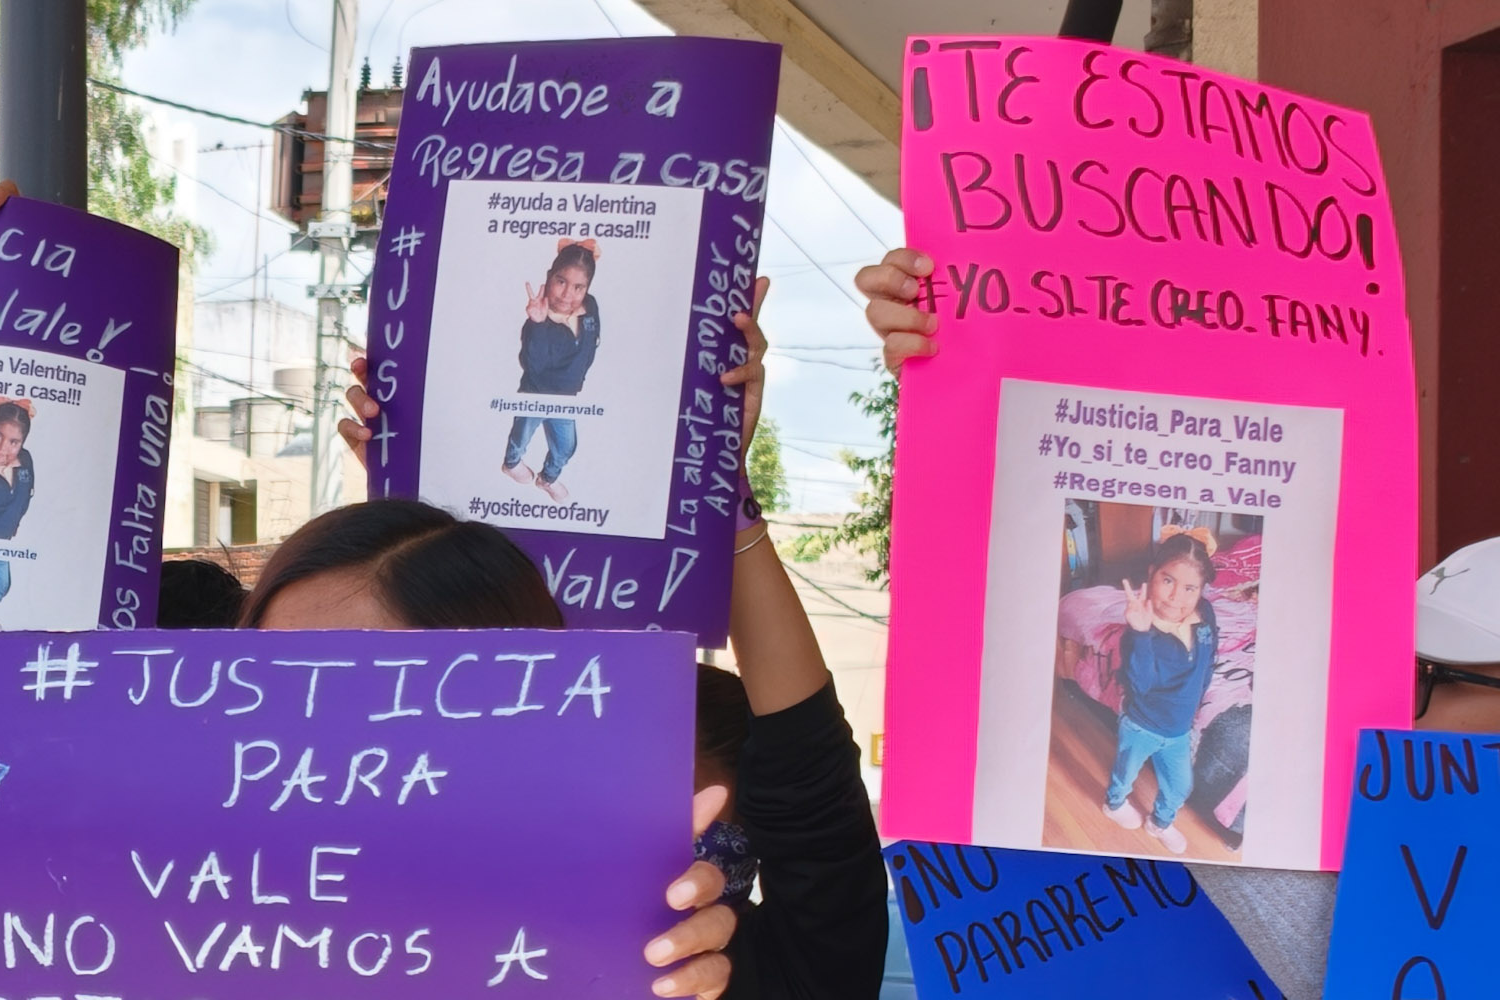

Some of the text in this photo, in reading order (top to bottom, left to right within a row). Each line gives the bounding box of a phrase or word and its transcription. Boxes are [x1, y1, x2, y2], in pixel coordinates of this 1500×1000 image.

[416, 53, 683, 128] Ayudame a
[1073, 50, 1377, 197] ESTAMOS
[411, 134, 585, 188] Regresa
[609, 151, 646, 185] a
[487, 191, 657, 216] #ayuda a Valentina
[487, 218, 651, 240] a regresar a casa!!!
[939, 150, 1382, 296] BUSCANDO!
[9, 356, 87, 387] Valentina
[15, 383, 26, 397] a
[29, 387, 82, 406] casa!!!
[667, 240, 730, 536] La alerta amber
[490, 398, 605, 417] #justiciaparavale
[1054, 398, 1284, 443] #Justicia_Para_Vale
[1038, 433, 1297, 484] #Yo_si_te_creo_Fanny
[468, 496, 610, 528] #yositecreofany
[1053, 470, 1282, 509] #Regresen_a_Vale
[114, 481, 158, 575] Falta
[97, 586, 141, 632] os
[222, 739, 448, 812] PARA
[129, 845, 362, 905] VALE
[3, 911, 548, 988] NO VAMOS A
[933, 857, 1198, 995] PARAREMO
